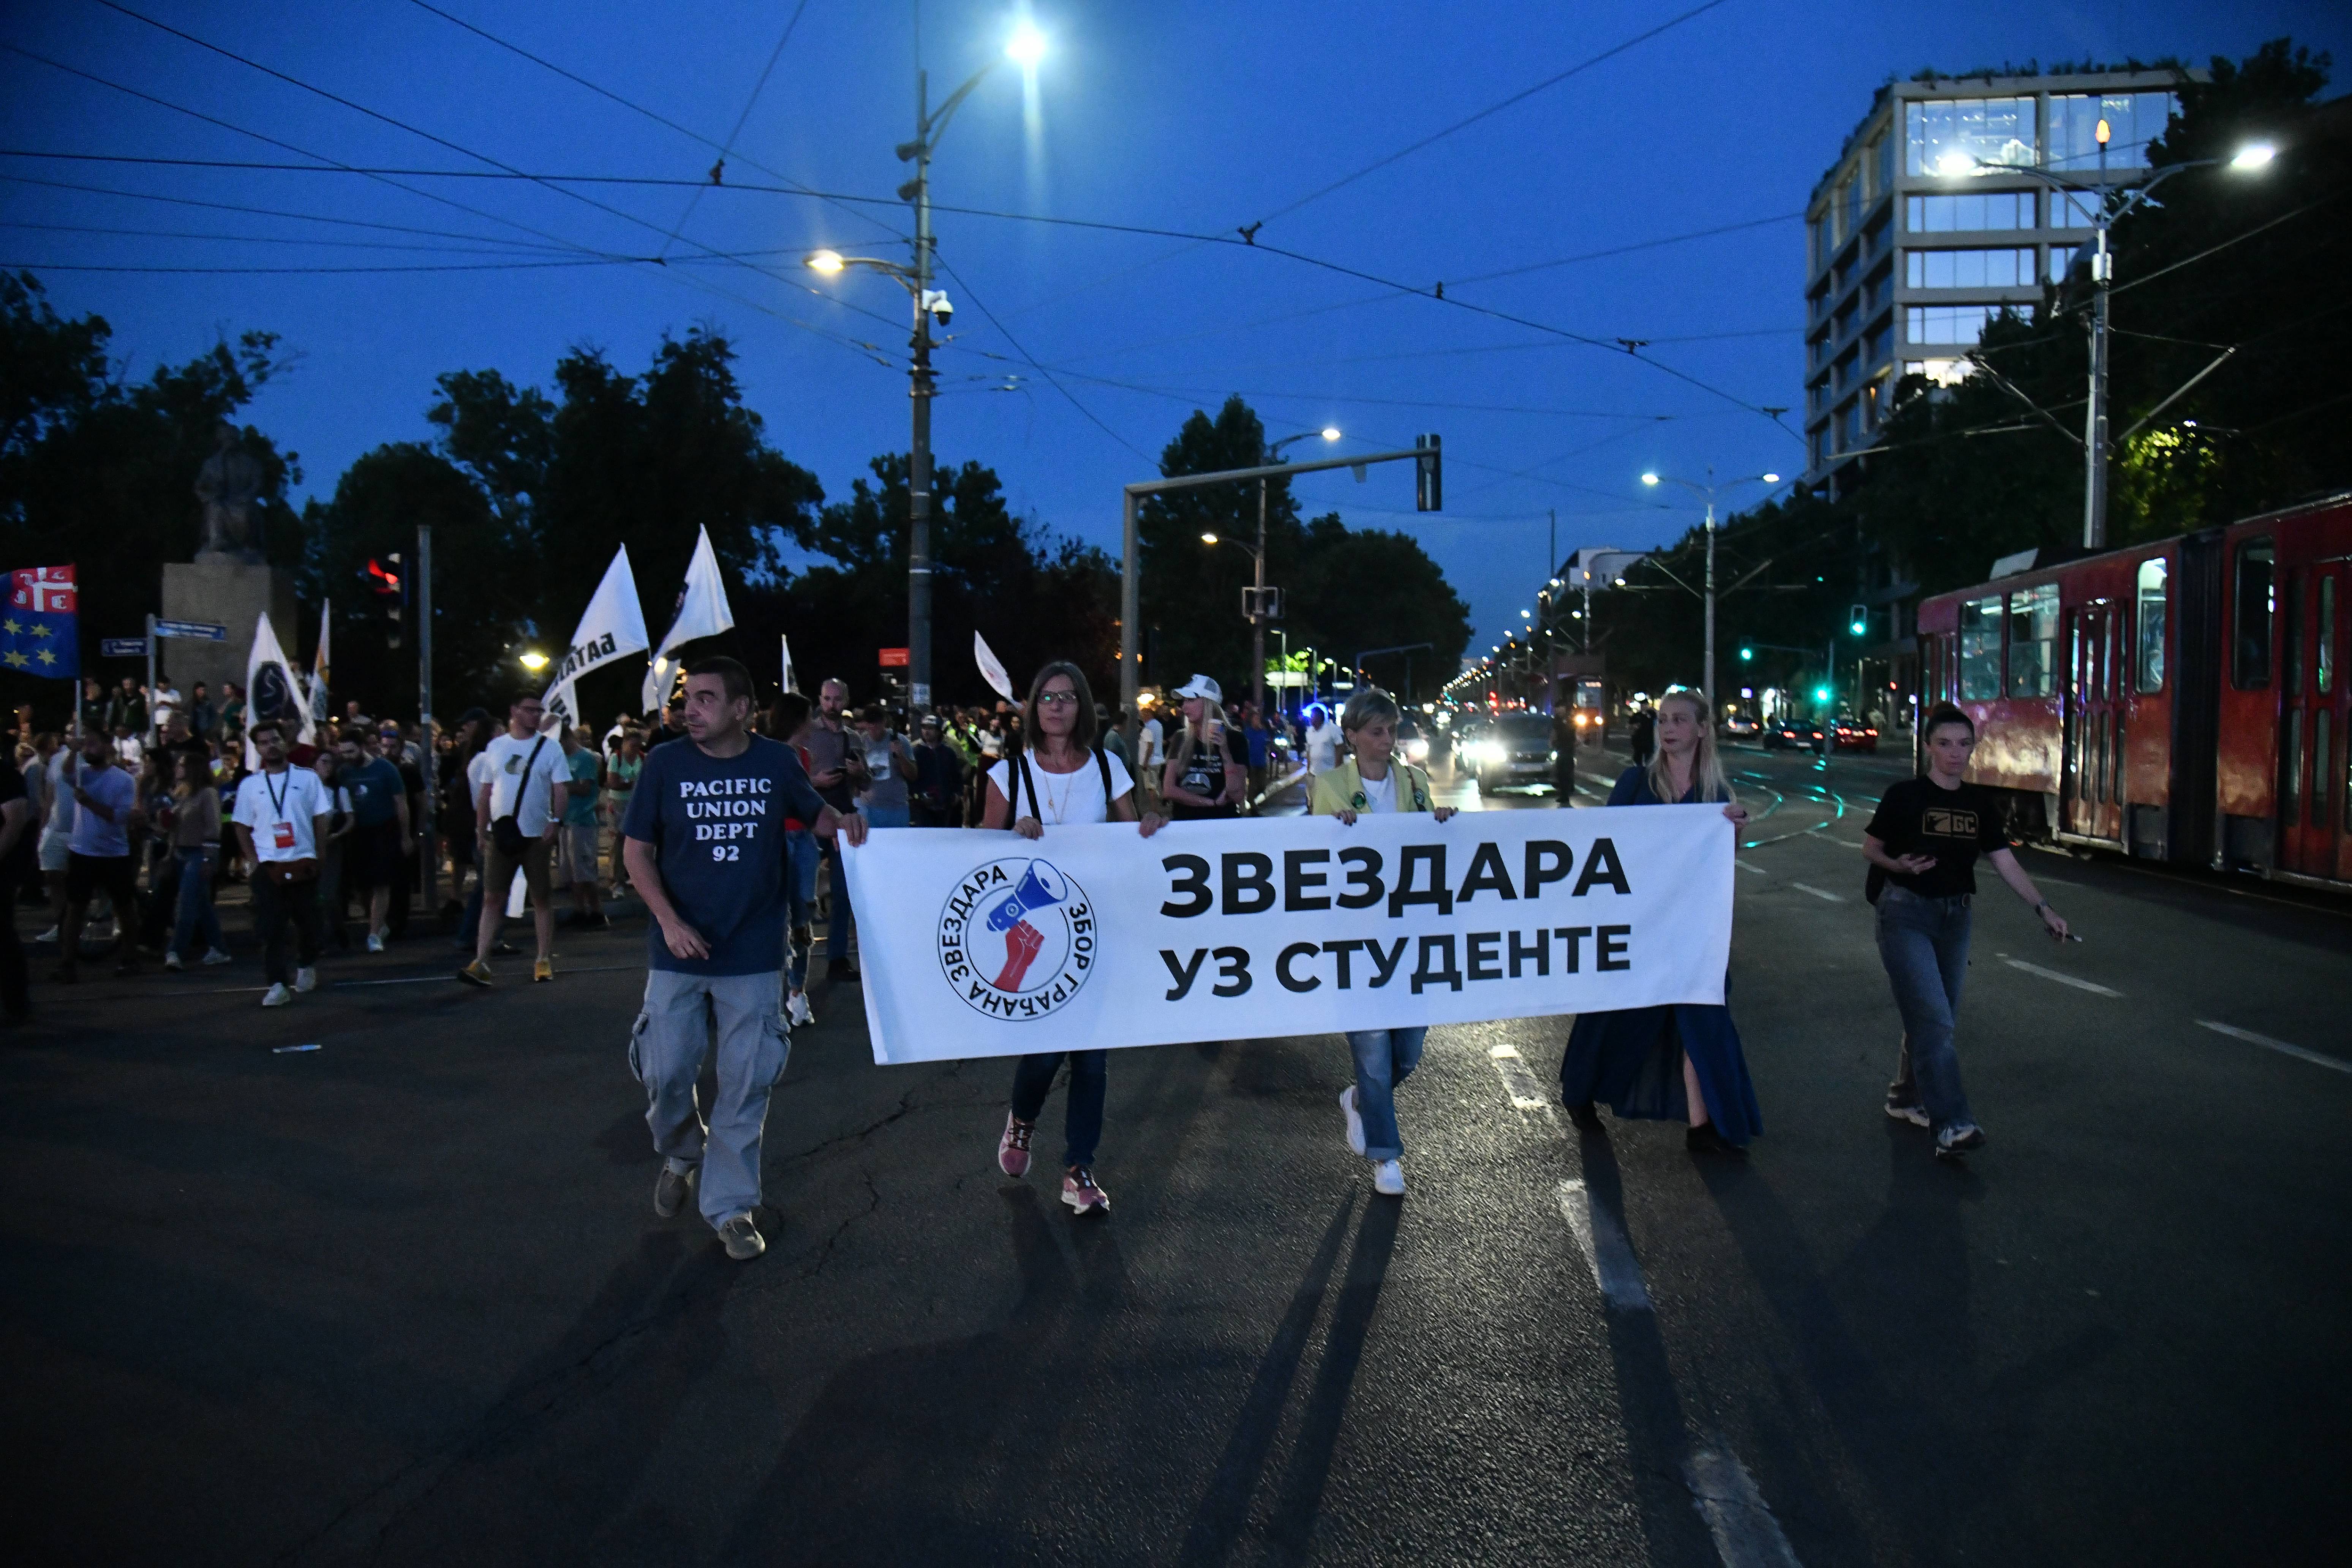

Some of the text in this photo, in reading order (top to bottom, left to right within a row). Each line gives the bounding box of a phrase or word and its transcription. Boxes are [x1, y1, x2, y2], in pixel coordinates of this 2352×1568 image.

[680, 778, 771, 798] PACIFIC
[686, 800, 767, 819] UNION
[695, 822, 758, 840] DEPT
[712, 845, 740, 861] 92
[1160, 838, 1632, 918] ЗВЕЗДАРА
[942, 865, 1092, 1016] ЗБОР ГРАЂАНА ЗВЕЗДАРА
[1159, 924, 1632, 1002] УЗ СТУДЕНТЕ
